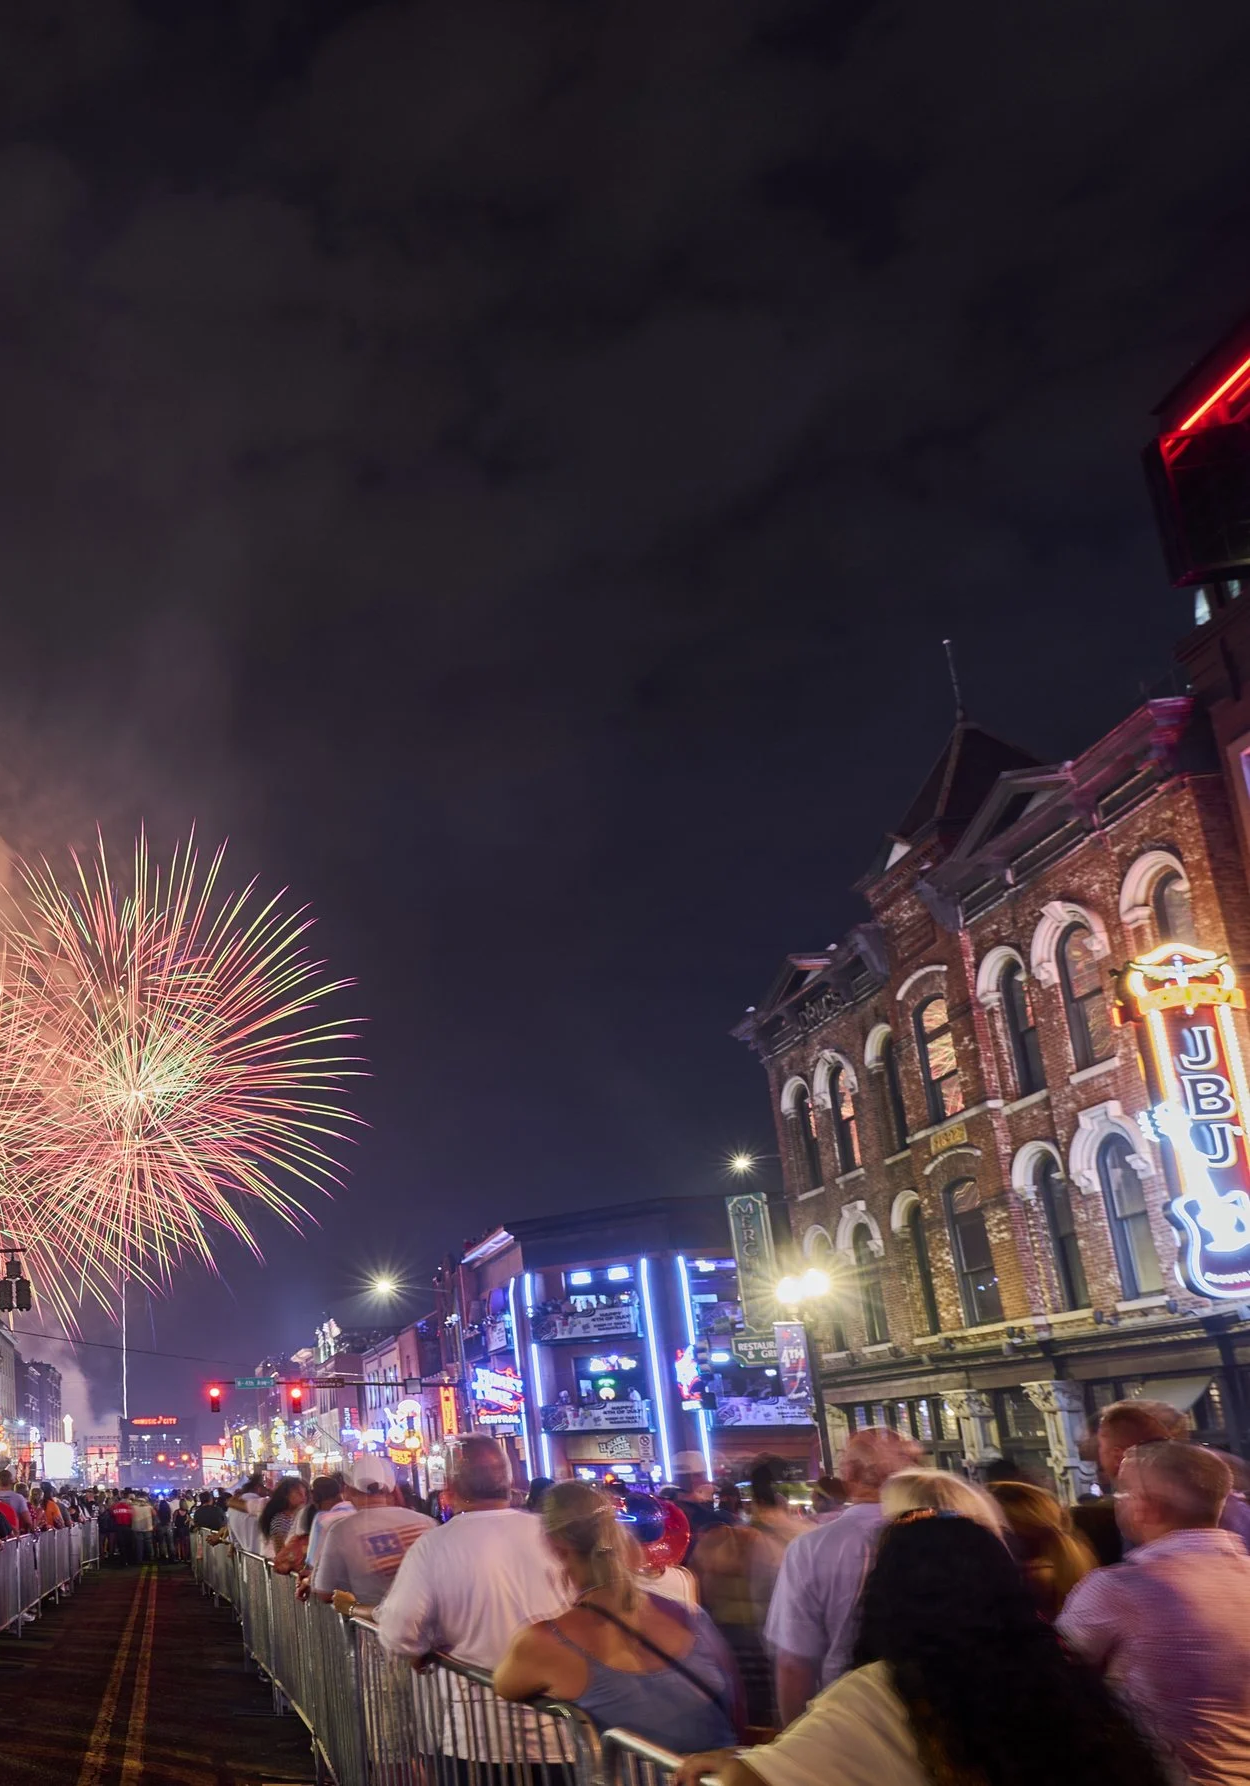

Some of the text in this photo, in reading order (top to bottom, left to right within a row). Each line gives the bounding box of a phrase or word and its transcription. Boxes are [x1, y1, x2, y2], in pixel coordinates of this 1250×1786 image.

[738, 1341, 778, 1352] RESTAUR
[761, 1349, 778, 1359] GRI
[781, 1348, 806, 1368] 4TH
[162, 1417, 177, 1425] CITY
